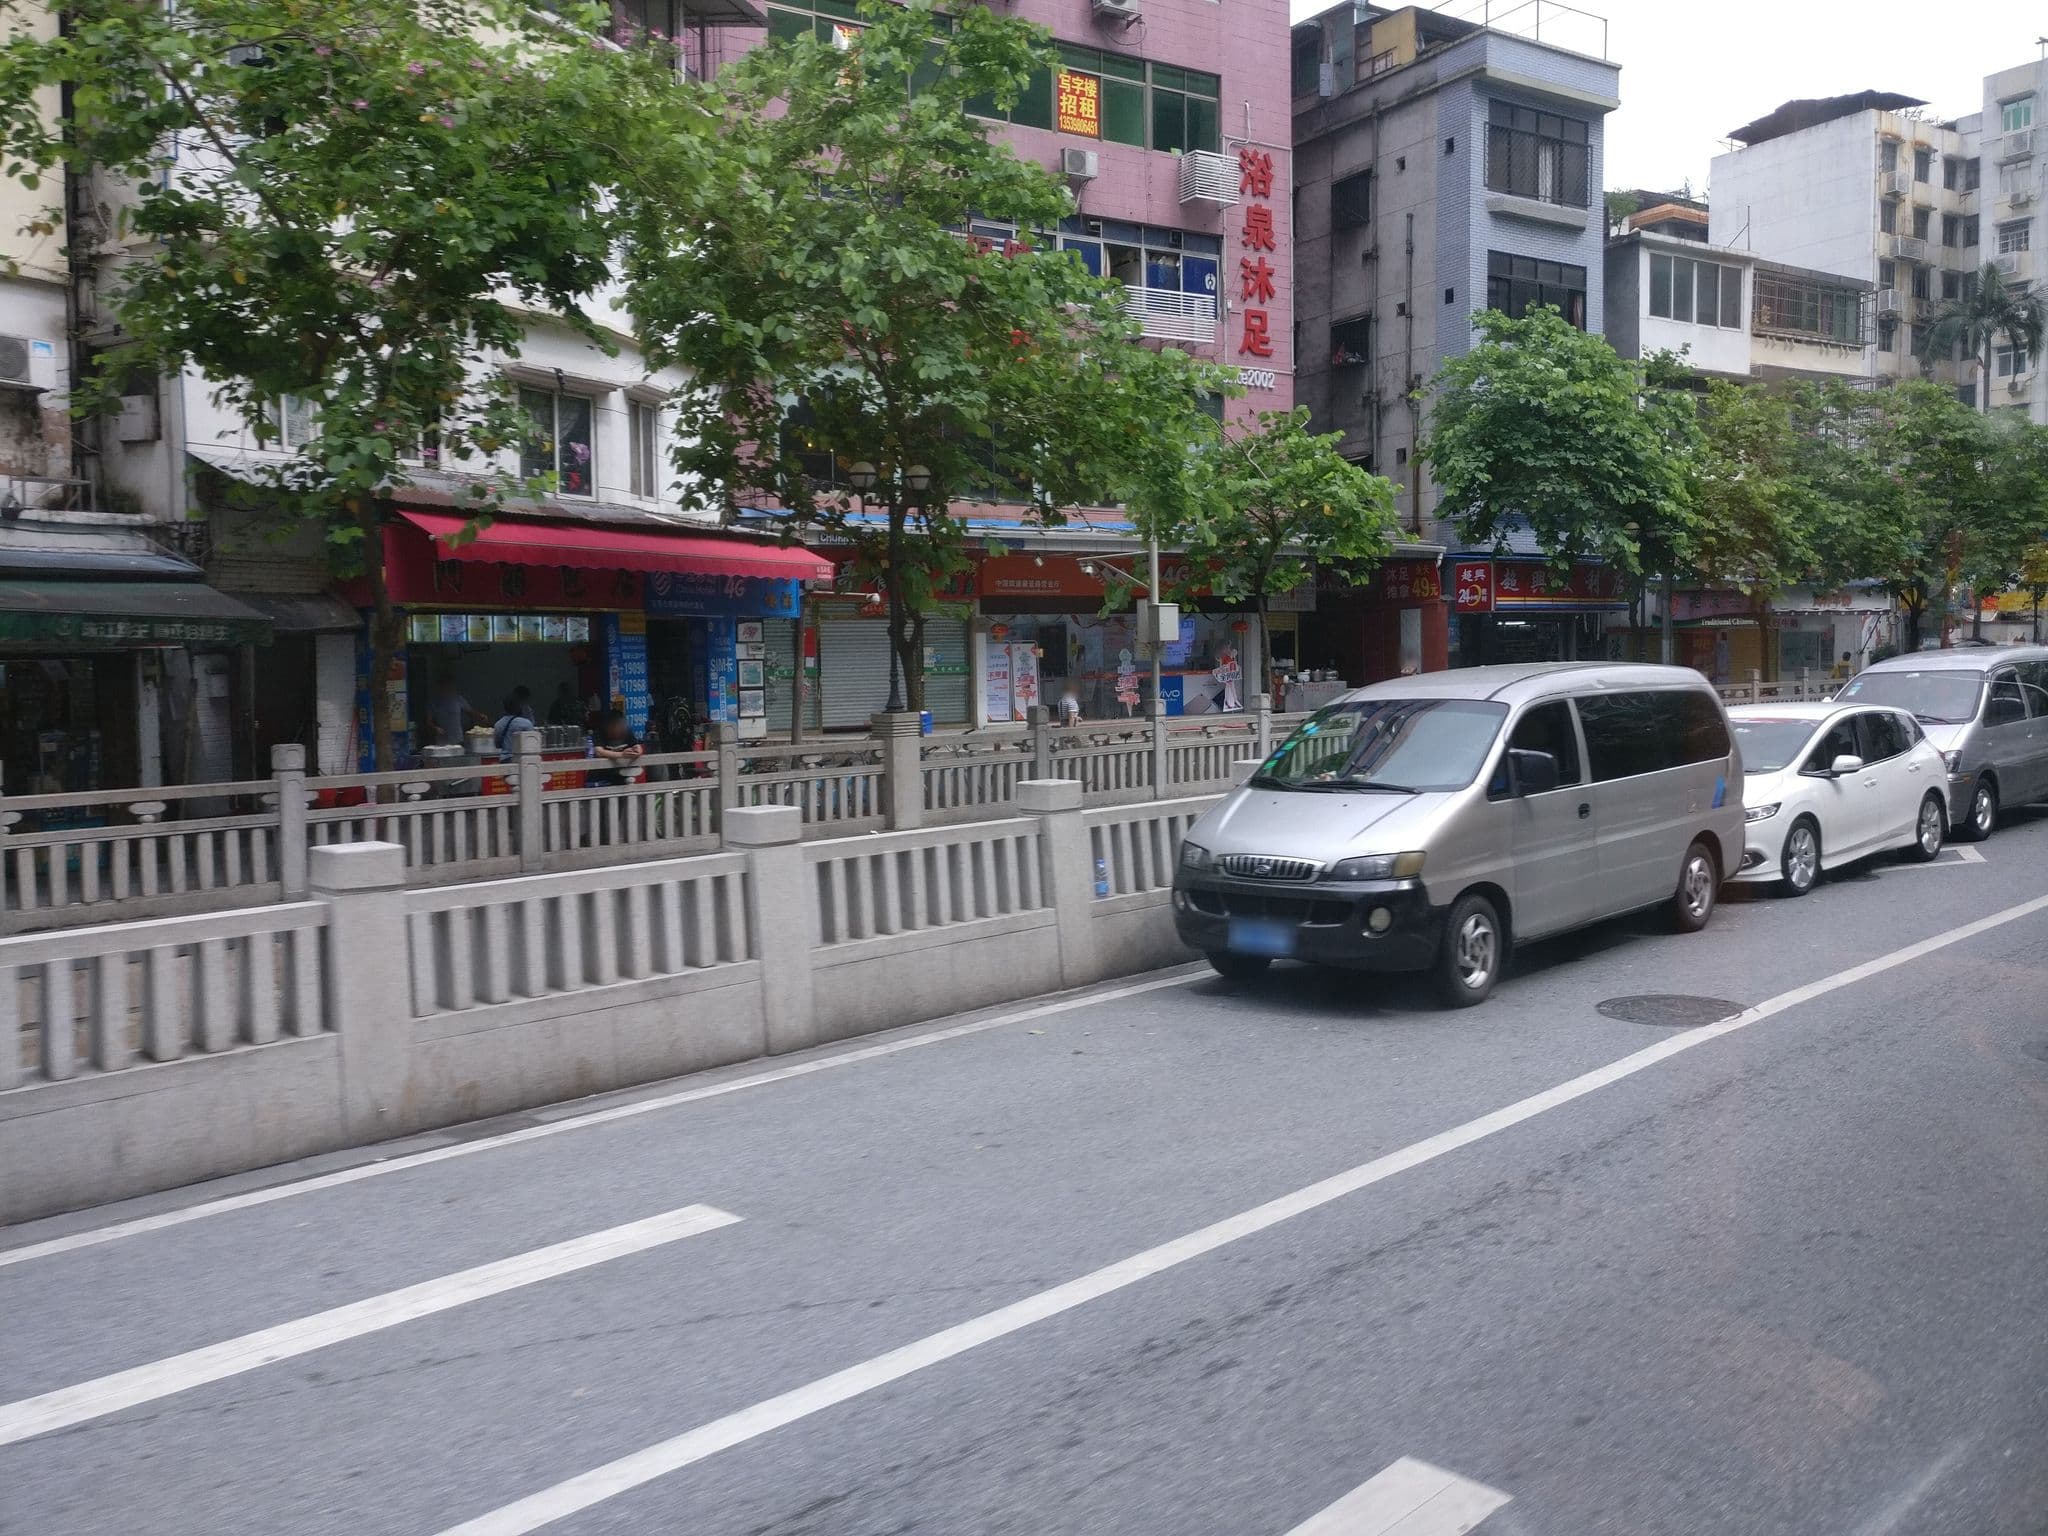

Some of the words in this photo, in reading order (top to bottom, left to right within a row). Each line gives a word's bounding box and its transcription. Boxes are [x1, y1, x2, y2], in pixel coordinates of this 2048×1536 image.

[1058, 73, 1097, 98] 写字楼
[1059, 92, 1097, 119] 招租
[1238, 148, 1277, 357] 浴泉沐足
[724, 577, 745, 598] 4G
